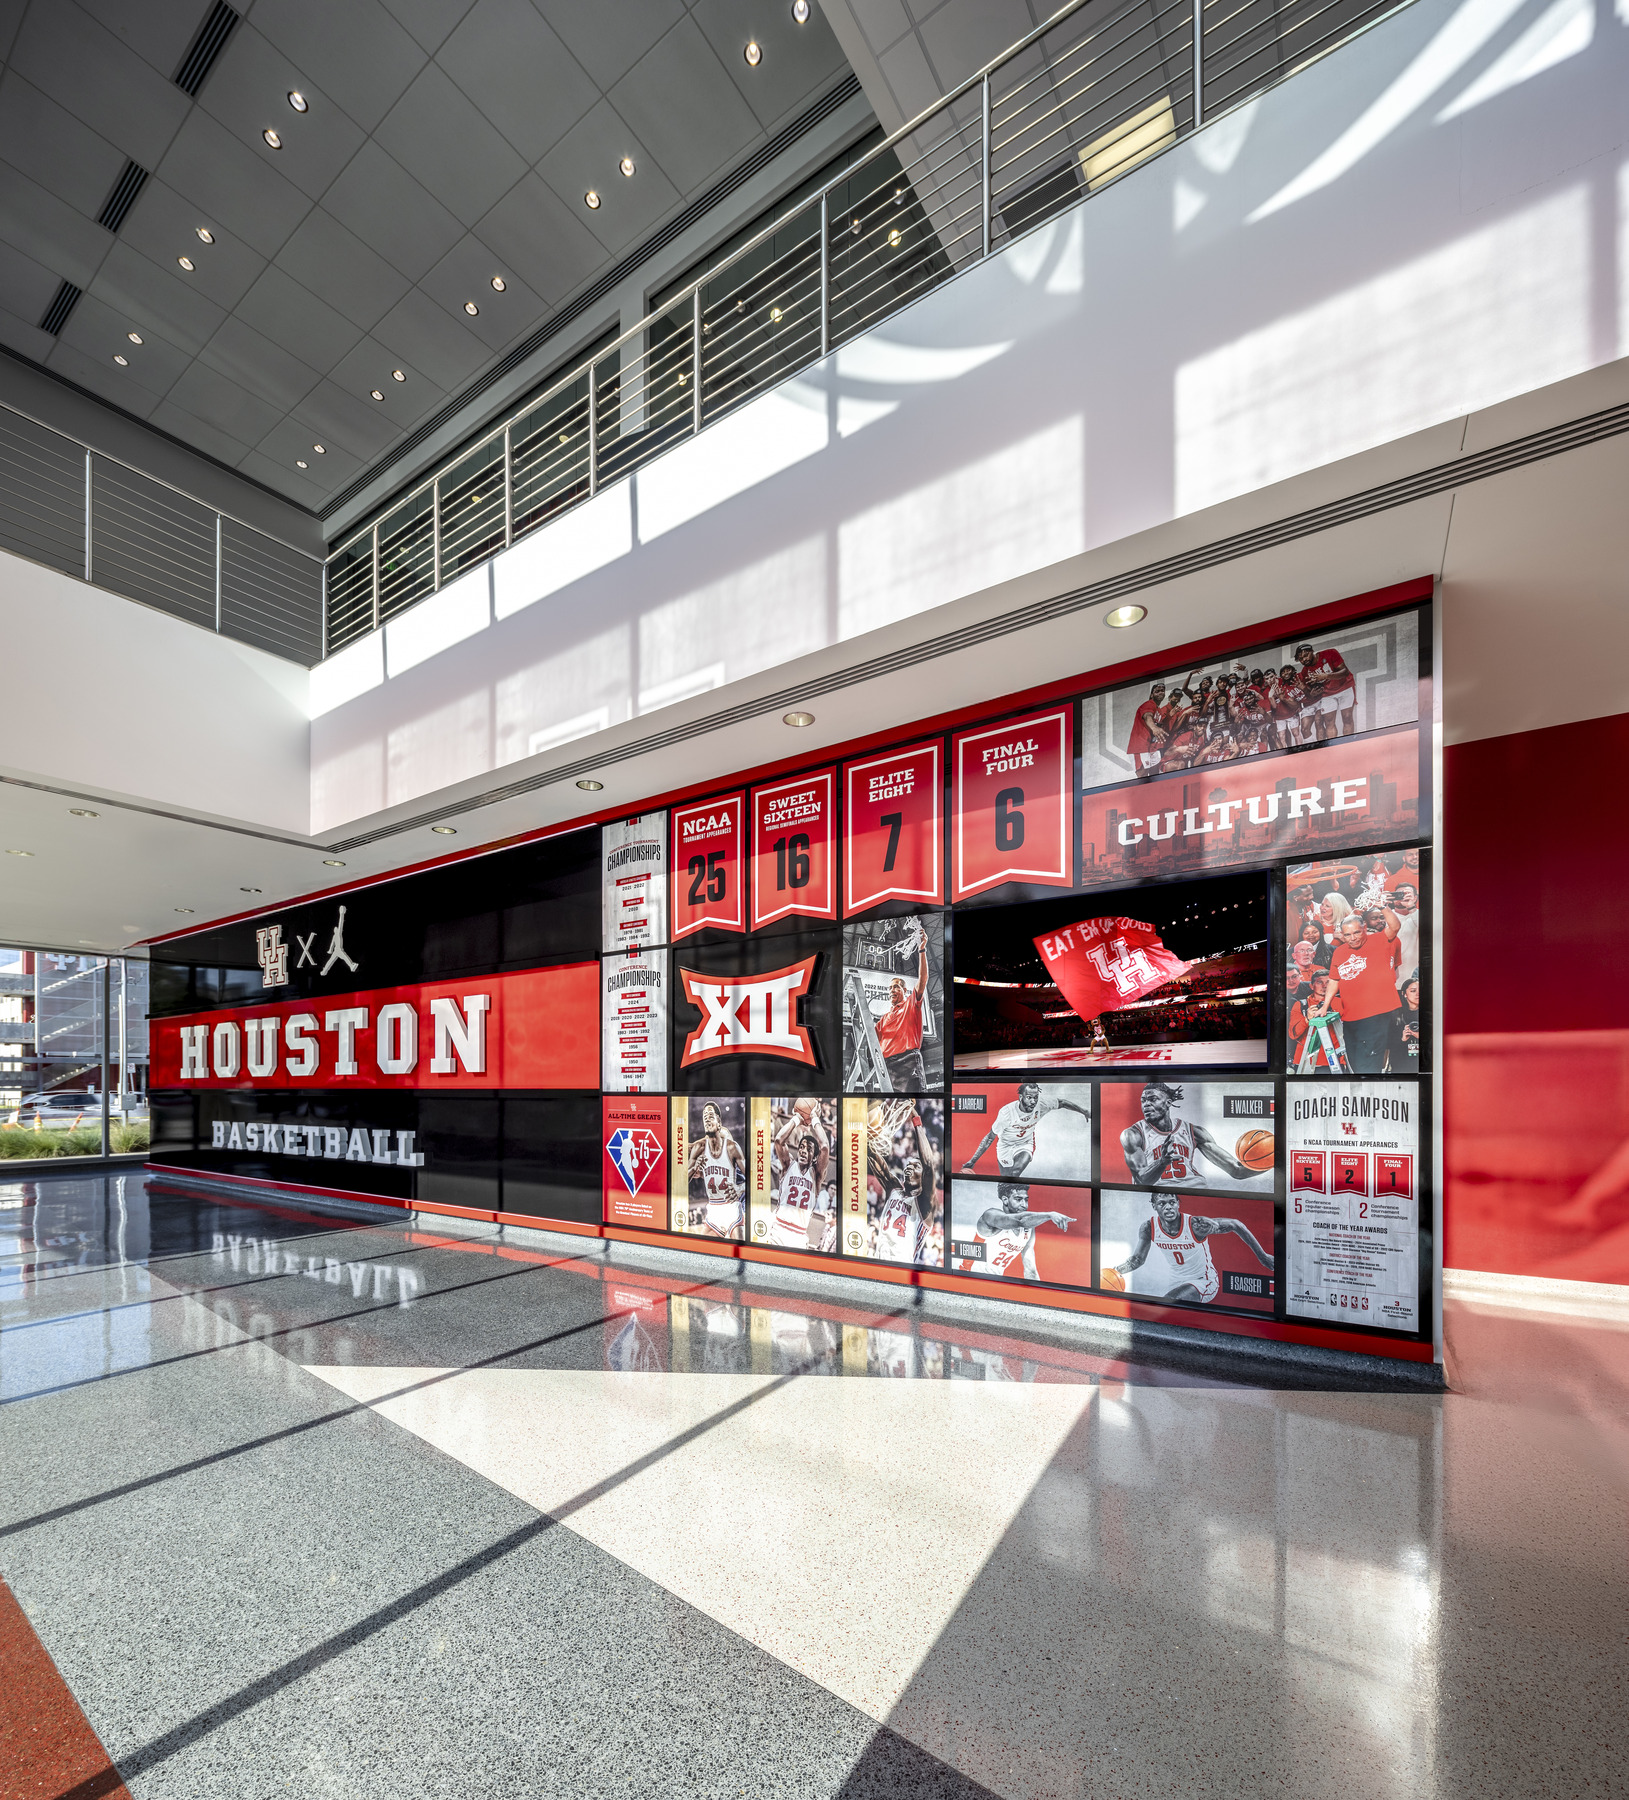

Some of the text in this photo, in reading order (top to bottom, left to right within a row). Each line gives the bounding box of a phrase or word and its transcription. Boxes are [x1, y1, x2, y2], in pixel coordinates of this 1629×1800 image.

[982, 738, 1039, 763] FINAL
[985, 753, 1034, 776] FOUR
[868, 768, 915, 790] ELITE
[769, 790, 816, 811] SWEET
[868, 782, 915, 803] EIGHT
[763, 802, 822, 824] SIXTEEN
[995, 787, 1025, 852] 6
[1117, 776, 1367, 846] CULTURE
[683, 812, 732, 836] NCAA
[683, 827, 732, 843] TOURNAMENT APPEARANCES
[880, 812, 902, 873] 7
[607, 844, 661, 872] CHAMPIONSHIPS
[773, 833, 810, 891] 16
[688, 850, 726, 906] 25
[1042, 929, 1075, 961] EAT
[619, 965, 648, 973] CONFERENCE
[1086, 936, 1160, 997] UH
[607, 970, 661, 993] CHAMPIONSHIPS
[689, 969, 805, 1056] XII
[180, 994, 490, 1078] HOUSTON
[1234, 1099, 1263, 1115] WALKER
[1294, 1096, 1409, 1123] COACH SAMPSON
[212, 1120, 425, 1167] BASKETBALL
[638, 1139, 650, 1160] 75
[851, 1133, 859, 1212] OLAJUWON
[1303, 1167, 1312, 1182] 5
[1345, 1169, 1354, 1184] 2
[1389, 1171, 1396, 1186] 1
[707, 1177, 728, 1194] 44
[786, 1186, 811, 1210] 22
[1294, 1198, 1302, 1214] 5
[1359, 1202, 1368, 1219] 2
[883, 1210, 908, 1237] 34
[1312, 1221, 1331, 1229] COACH
[1364, 1226, 1388, 1234] AWARDS
[962, 1244, 982, 1258] GRIMES
[1156, 1242, 1195, 1251] HOUSTON
[992, 1252, 1014, 1268] 24
[1173, 1251, 1184, 1265] 0
[1234, 1276, 1261, 1294] SASSER
[1383, 1305, 1412, 1313] HOUSTON
